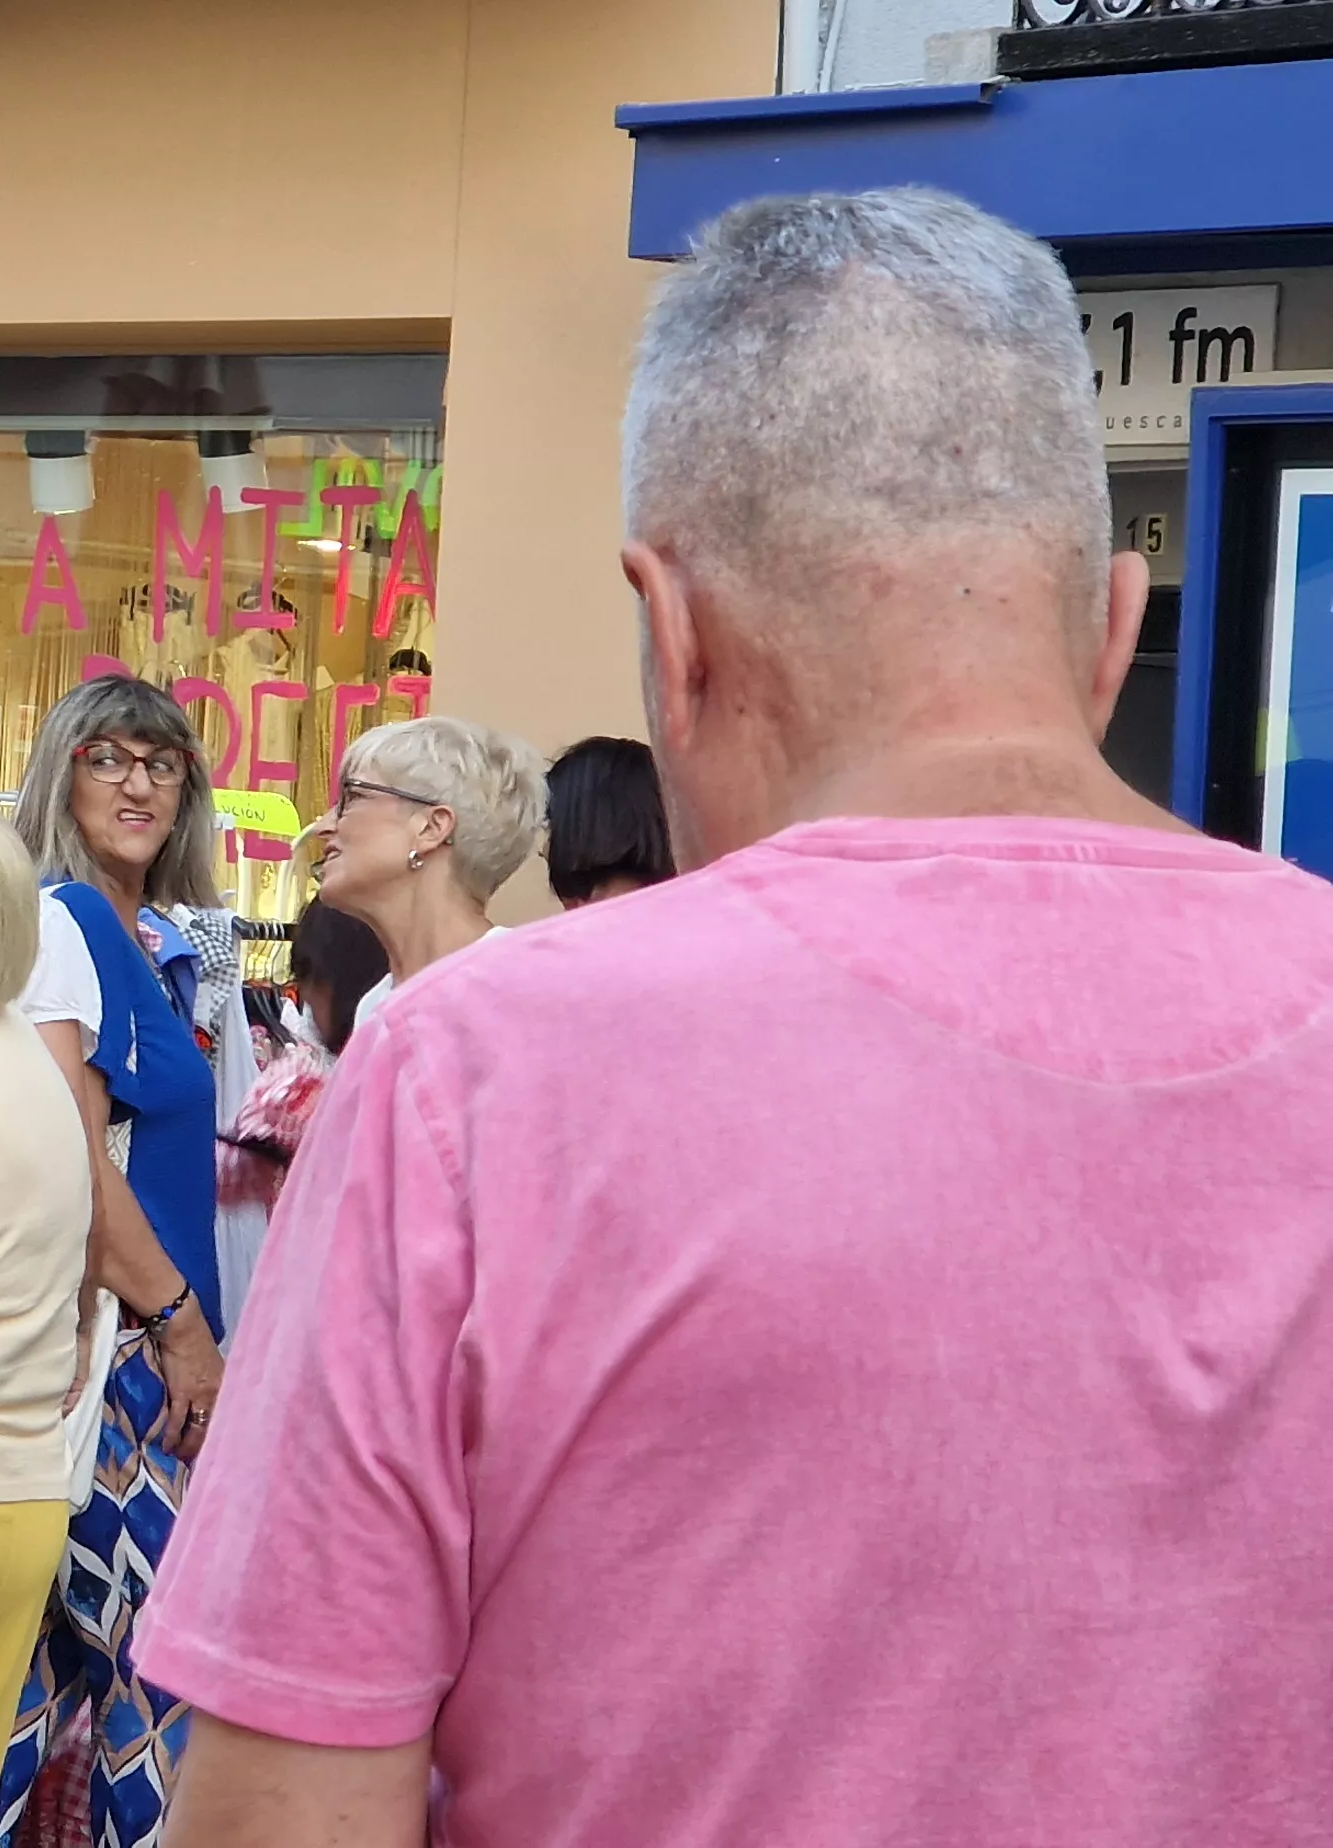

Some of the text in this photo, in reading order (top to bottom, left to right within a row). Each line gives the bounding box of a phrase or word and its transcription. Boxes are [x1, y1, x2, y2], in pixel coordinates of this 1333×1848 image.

[1169, 307, 1254, 385] fm
[1105, 415, 1183, 430] uesca
[1127, 517, 1163, 552] 15
[22, 514, 87, 636] A
